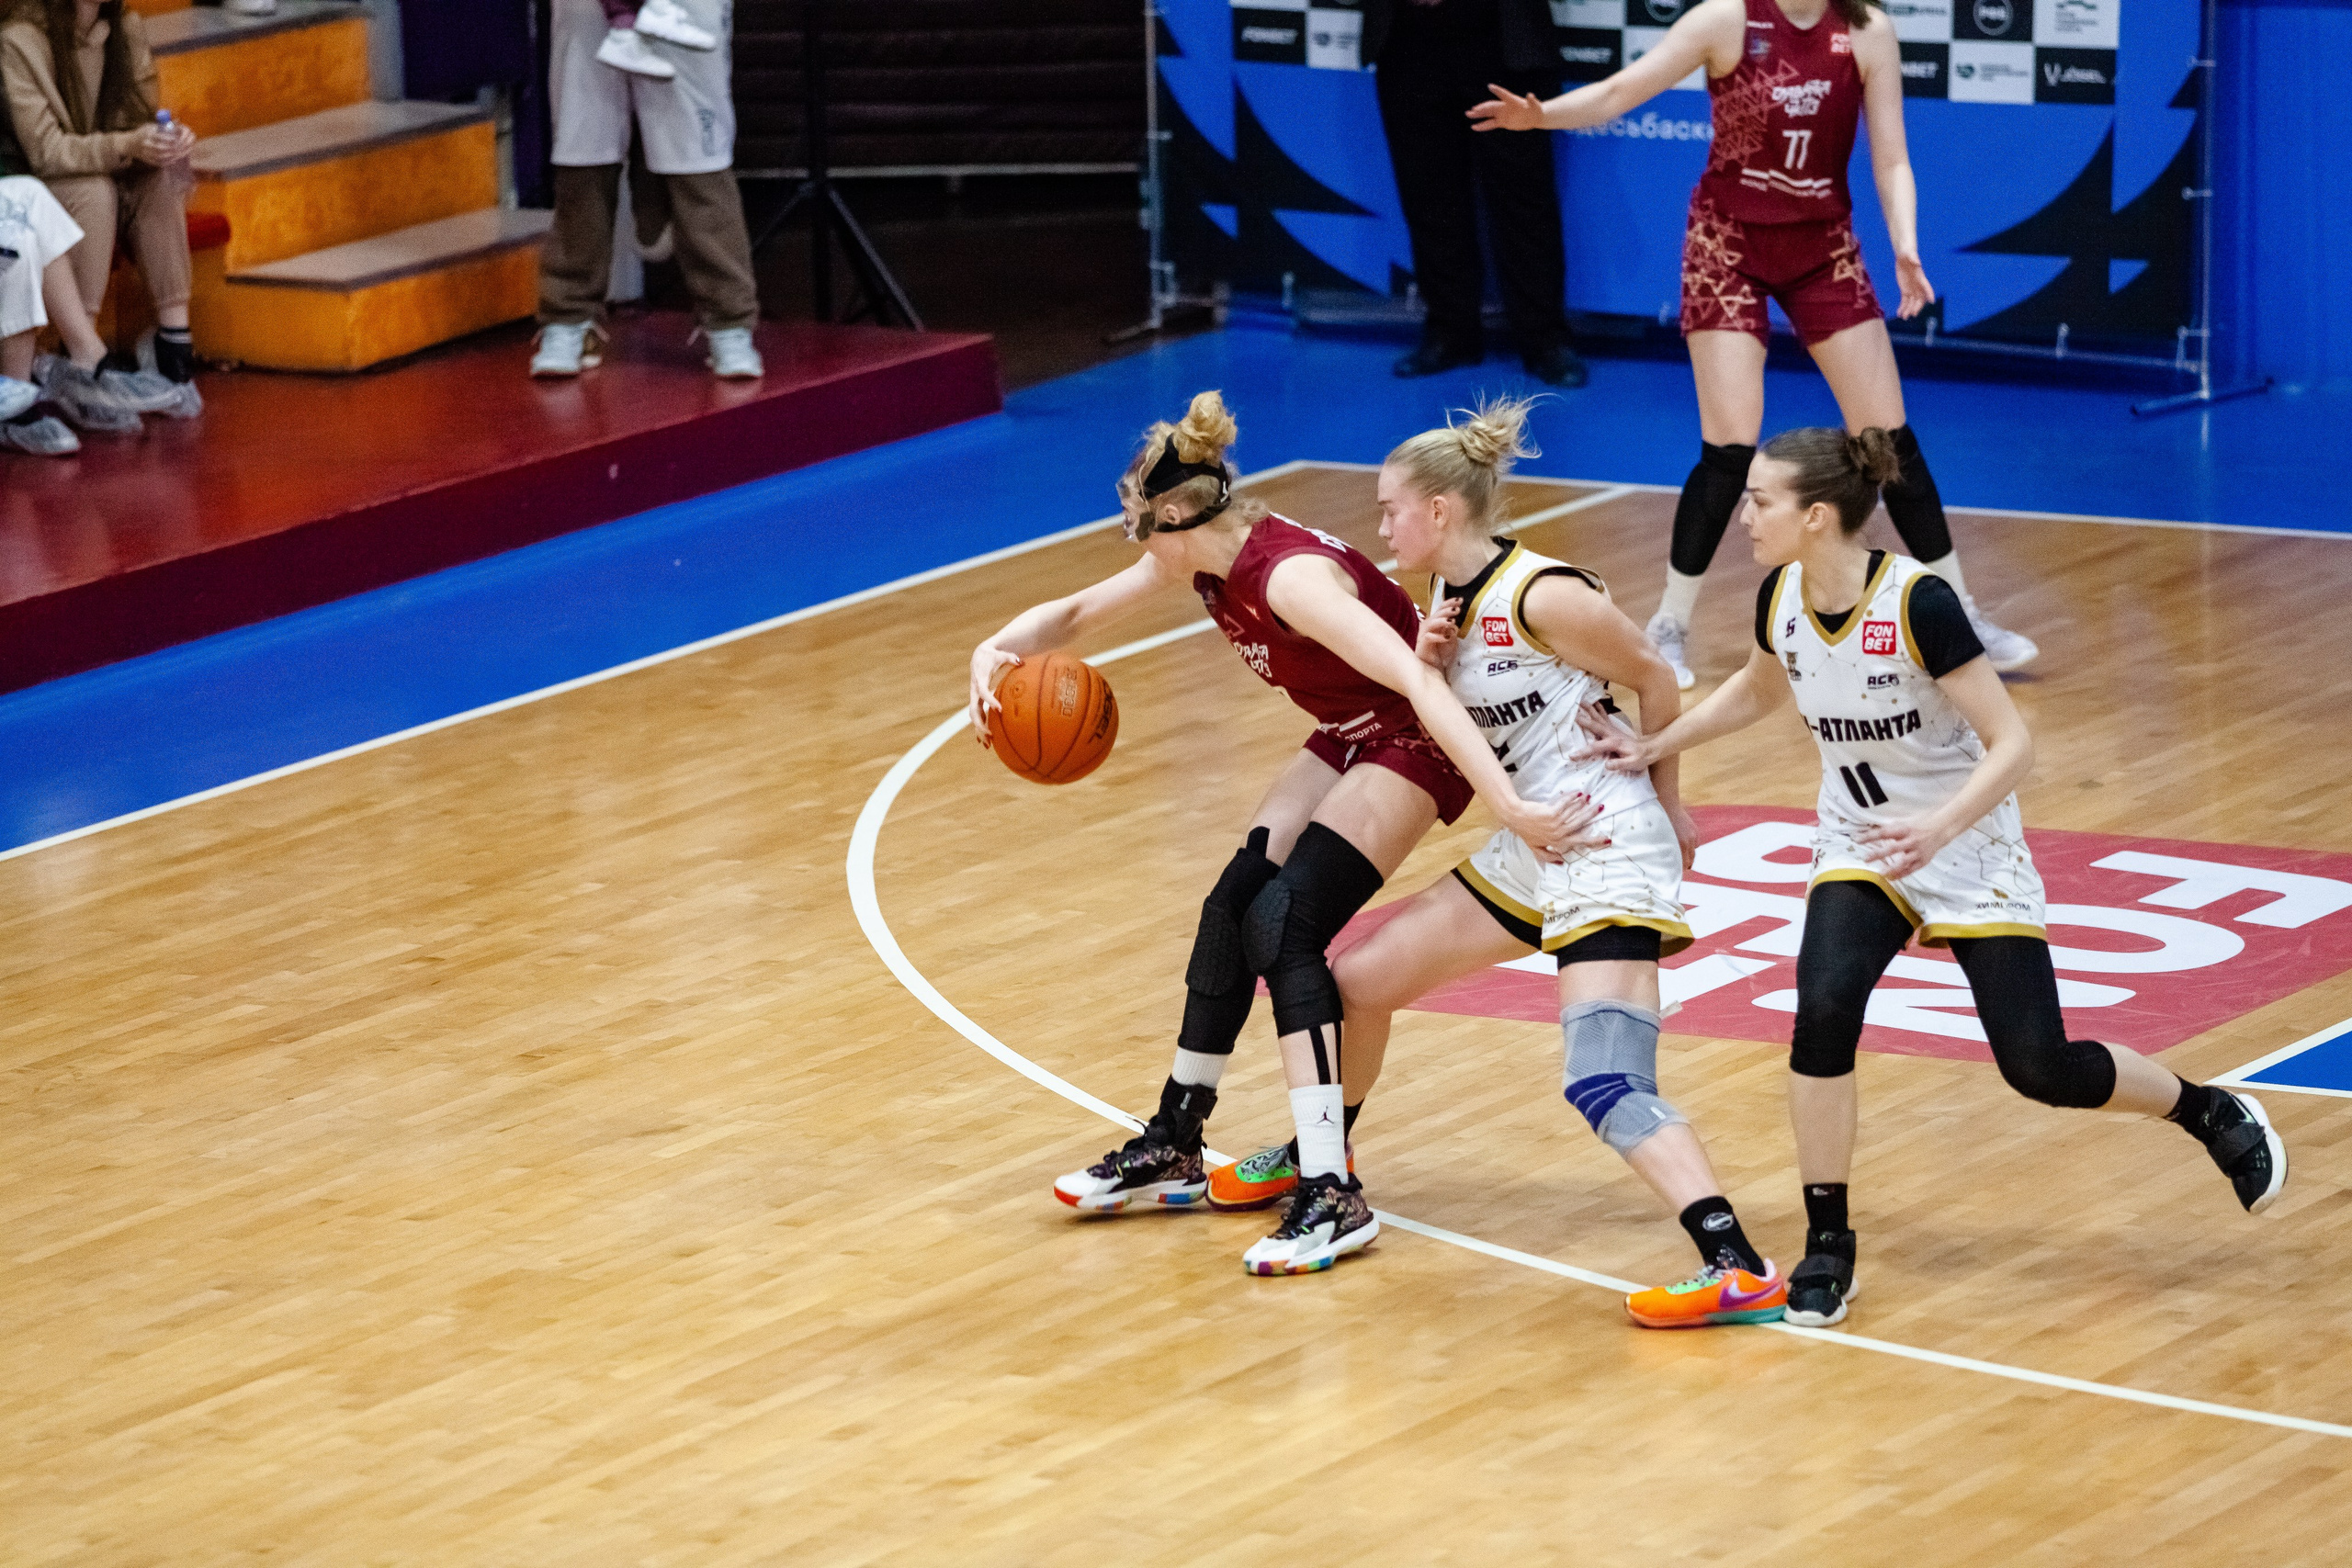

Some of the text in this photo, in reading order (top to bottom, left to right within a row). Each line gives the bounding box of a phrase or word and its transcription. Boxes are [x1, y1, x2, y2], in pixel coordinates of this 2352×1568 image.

[1782, 130, 1813, 169] 77
[1484, 620, 1507, 632] FON
[1864, 624, 1894, 638] FON
[1485, 631, 1509, 644] BET
[1863, 637, 1894, 651] BET
[1801, 708, 1922, 742] -АТЛАНТА
[1838, 761, 1889, 808] 11
